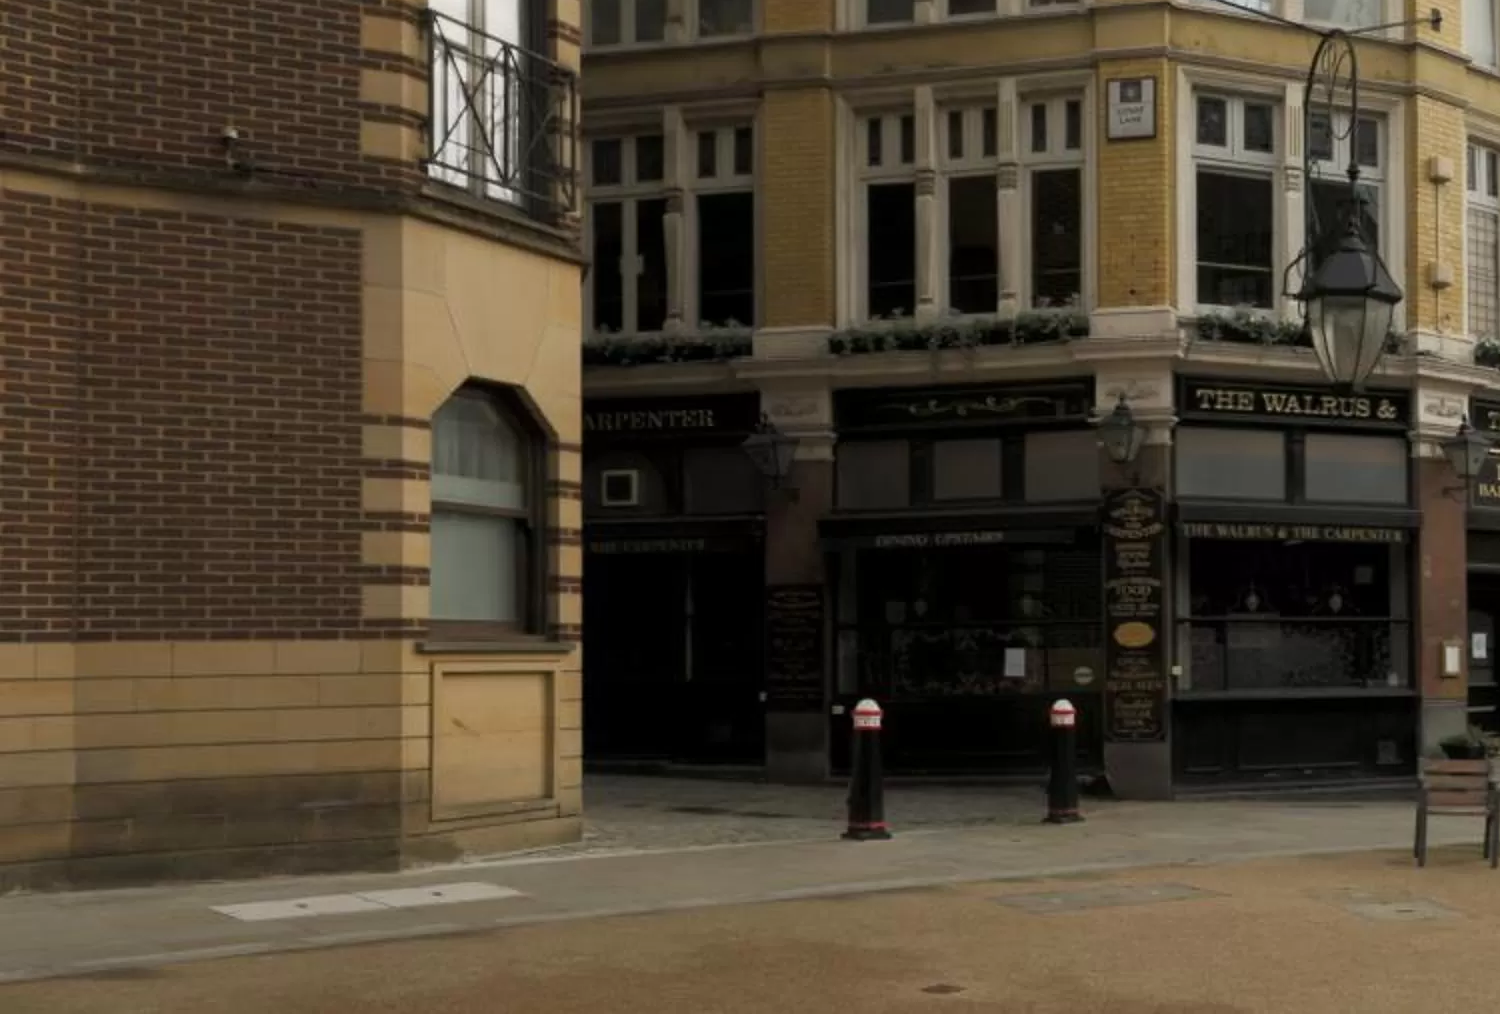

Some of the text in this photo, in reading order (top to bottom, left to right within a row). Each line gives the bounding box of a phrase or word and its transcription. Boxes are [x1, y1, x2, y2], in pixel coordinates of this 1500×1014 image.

[1195, 388, 1398, 419] THE WALRUS &
[1183, 523, 1215, 539] THE
[1216, 523, 1273, 539] WALRUS
[1292, 525, 1320, 539] THE
[1325, 526, 1403, 543] CARPENTER
